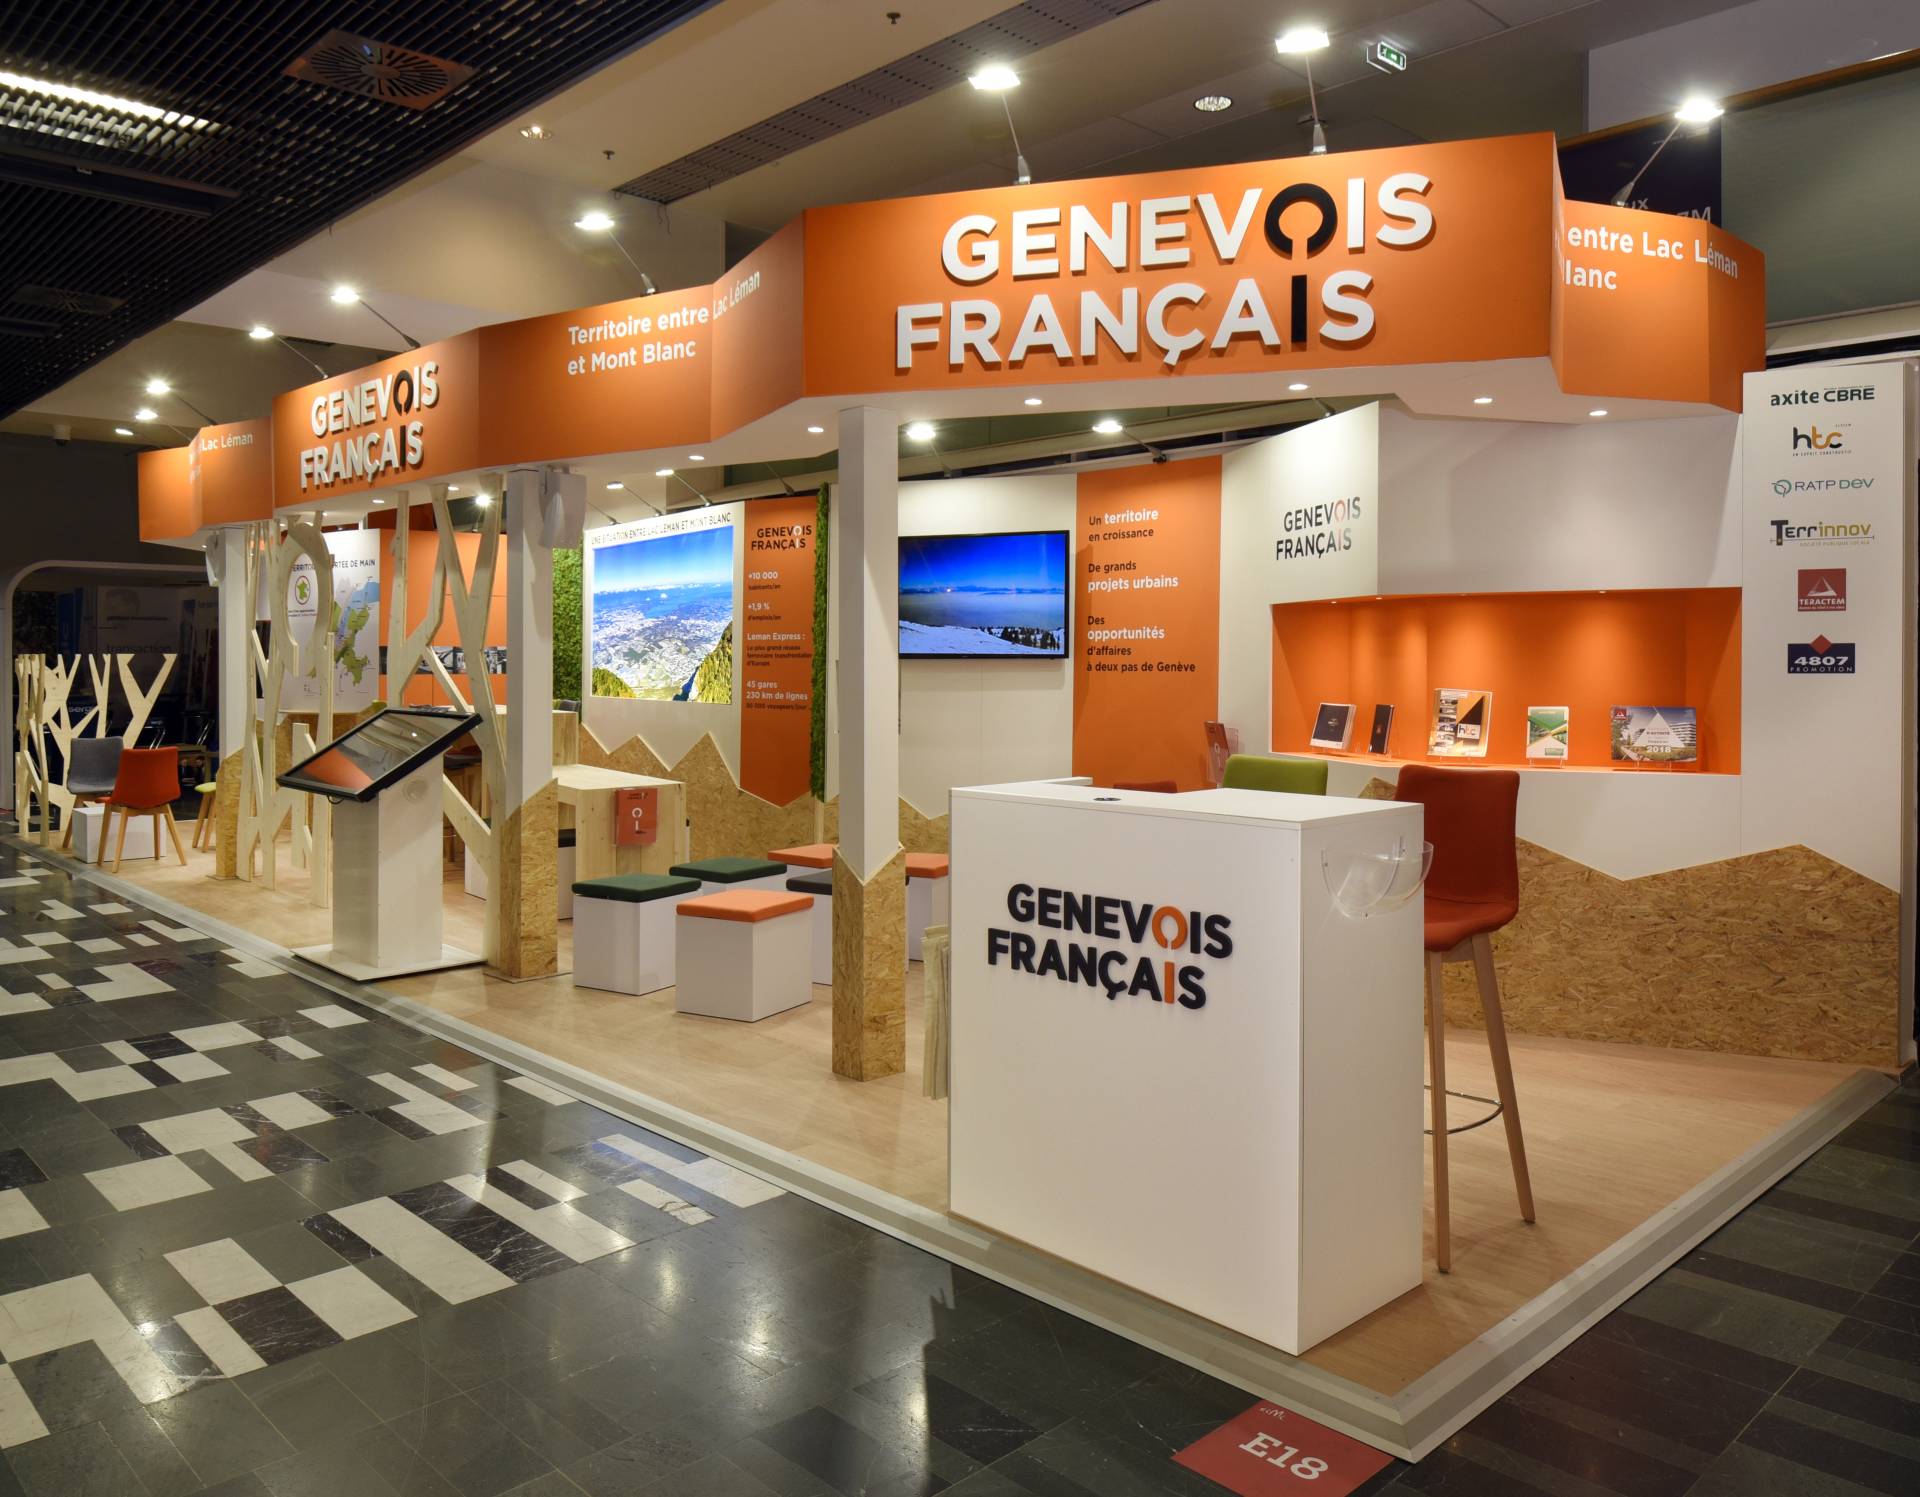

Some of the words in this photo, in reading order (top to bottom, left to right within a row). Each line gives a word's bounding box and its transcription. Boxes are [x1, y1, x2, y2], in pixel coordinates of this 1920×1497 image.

[942, 172, 1434, 282] GENEVOIS
[1567, 226, 1634, 253] entre
[1643, 231, 1684, 260] Lac
[1695, 239, 1738, 279] Léman
[1563, 259, 1617, 290] lanc
[568, 314, 652, 346] Territoire
[657, 307, 709, 331] entre
[712, 295, 728, 321] Lac
[729, 271, 760, 308] Léman
[896, 270, 1376, 367] FRANÇAIS
[567, 355, 585, 375] et
[591, 347, 637, 372] Mont
[643, 340, 696, 365] Blanc
[311, 361, 438, 437] GENEVOIS
[1771, 389, 1819, 406] axite
[1823, 387, 1875, 402] CBRE
[201, 436, 218, 451] Lac
[221, 432, 254, 449] Léman
[1793, 425, 1842, 450] htc
[301, 420, 423, 489] FRANÇAIS
[1795, 480, 1836, 491] RATP
[1089, 516, 1102, 525] Un
[1104, 509, 1159, 525] territoire
[1284, 496, 1361, 532] GENEVOIS
[629, 527, 646, 539] ENTRE
[681, 519, 689, 530] ET
[689, 516, 707, 529] MONT
[709, 512, 732, 526] BLANC
[757, 525, 812, 538] GENEVOIS
[1088, 533, 1100, 542] en
[1103, 527, 1154, 541] croissance
[751, 538, 806, 551] FRANÇAIS
[1276, 527, 1352, 560] FRANÇAIS
[350, 560, 359, 568] DE
[360, 559, 376, 567] MAIN
[1088, 563, 1101, 573] De
[1104, 561, 1137, 574] grands
[762, 571, 778, 579] 000
[1088, 577, 1129, 593] projets
[1133, 575, 1179, 589] urbains
[1799, 598, 1845, 606] TERACTEM
[1087, 616, 1105, 625] Des
[772, 632, 801, 642] Express
[1087, 626, 1165, 642] opportunités
[1087, 645, 1132, 656] d'affaires
[1087, 661, 1092, 672] à
[1095, 662, 1118, 672] deux
[1121, 663, 1138, 673] pas
[1141, 662, 1153, 672] de
[1157, 661, 1196, 672] Genève
[1794, 656, 1849, 666] 4807
[746, 680, 756, 688] 45
[757, 681, 778, 690] gares
[746, 691, 760, 699] 230
[761, 691, 773, 699] km
[774, 691, 784, 700] de
[785, 691, 808, 701] lignes
[1007, 883, 1233, 959] GENEVOIS
[988, 927, 1207, 1010] FRANÇAIS
[1238, 1431, 1329, 1480] E18
